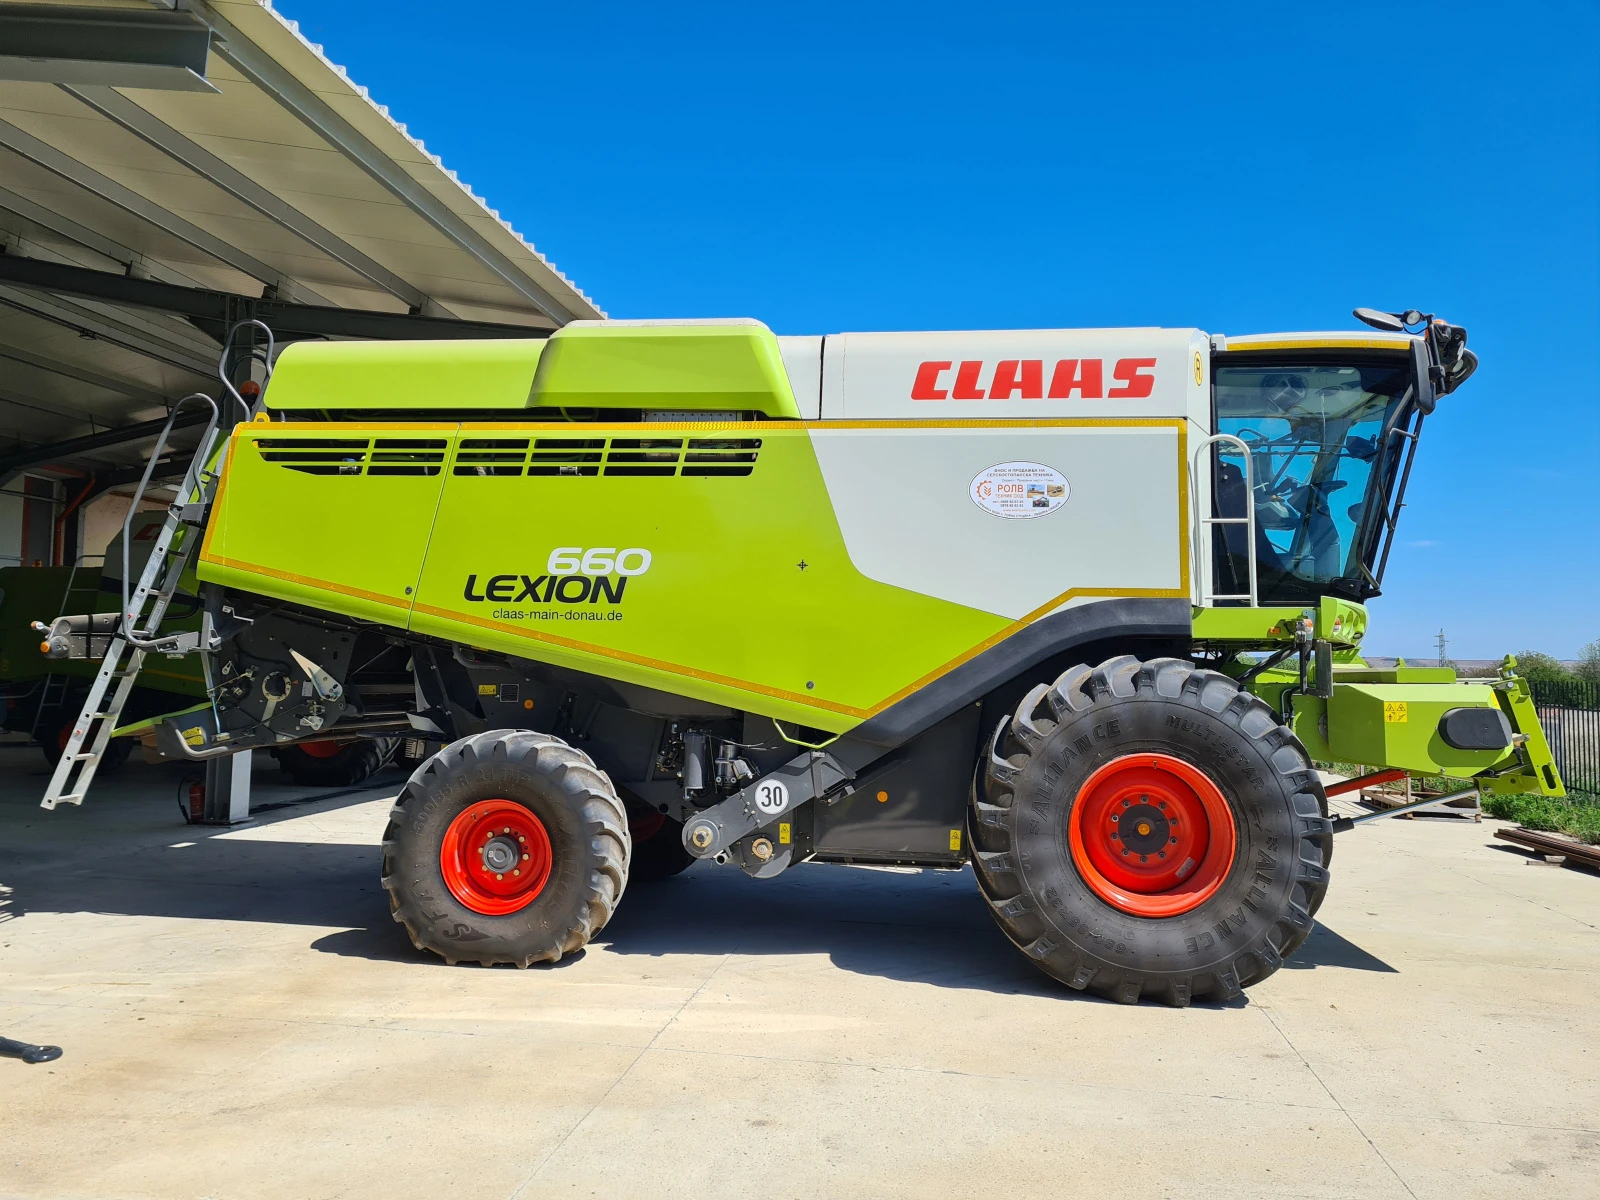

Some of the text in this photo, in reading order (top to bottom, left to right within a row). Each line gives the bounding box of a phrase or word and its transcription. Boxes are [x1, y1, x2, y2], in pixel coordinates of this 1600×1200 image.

[910, 357, 1157, 400] CLAAS
[997, 484, 1024, 493] РОЛВ
[547, 547, 652, 576] 660
[464, 574, 627, 604] LEXION
[492, 608, 623, 621] claas-main-donau.de
[1030, 718, 1121, 822] ALLIANCE
[760, 786, 783, 808] 30
[1184, 848, 1277, 957] ALLIANCE
